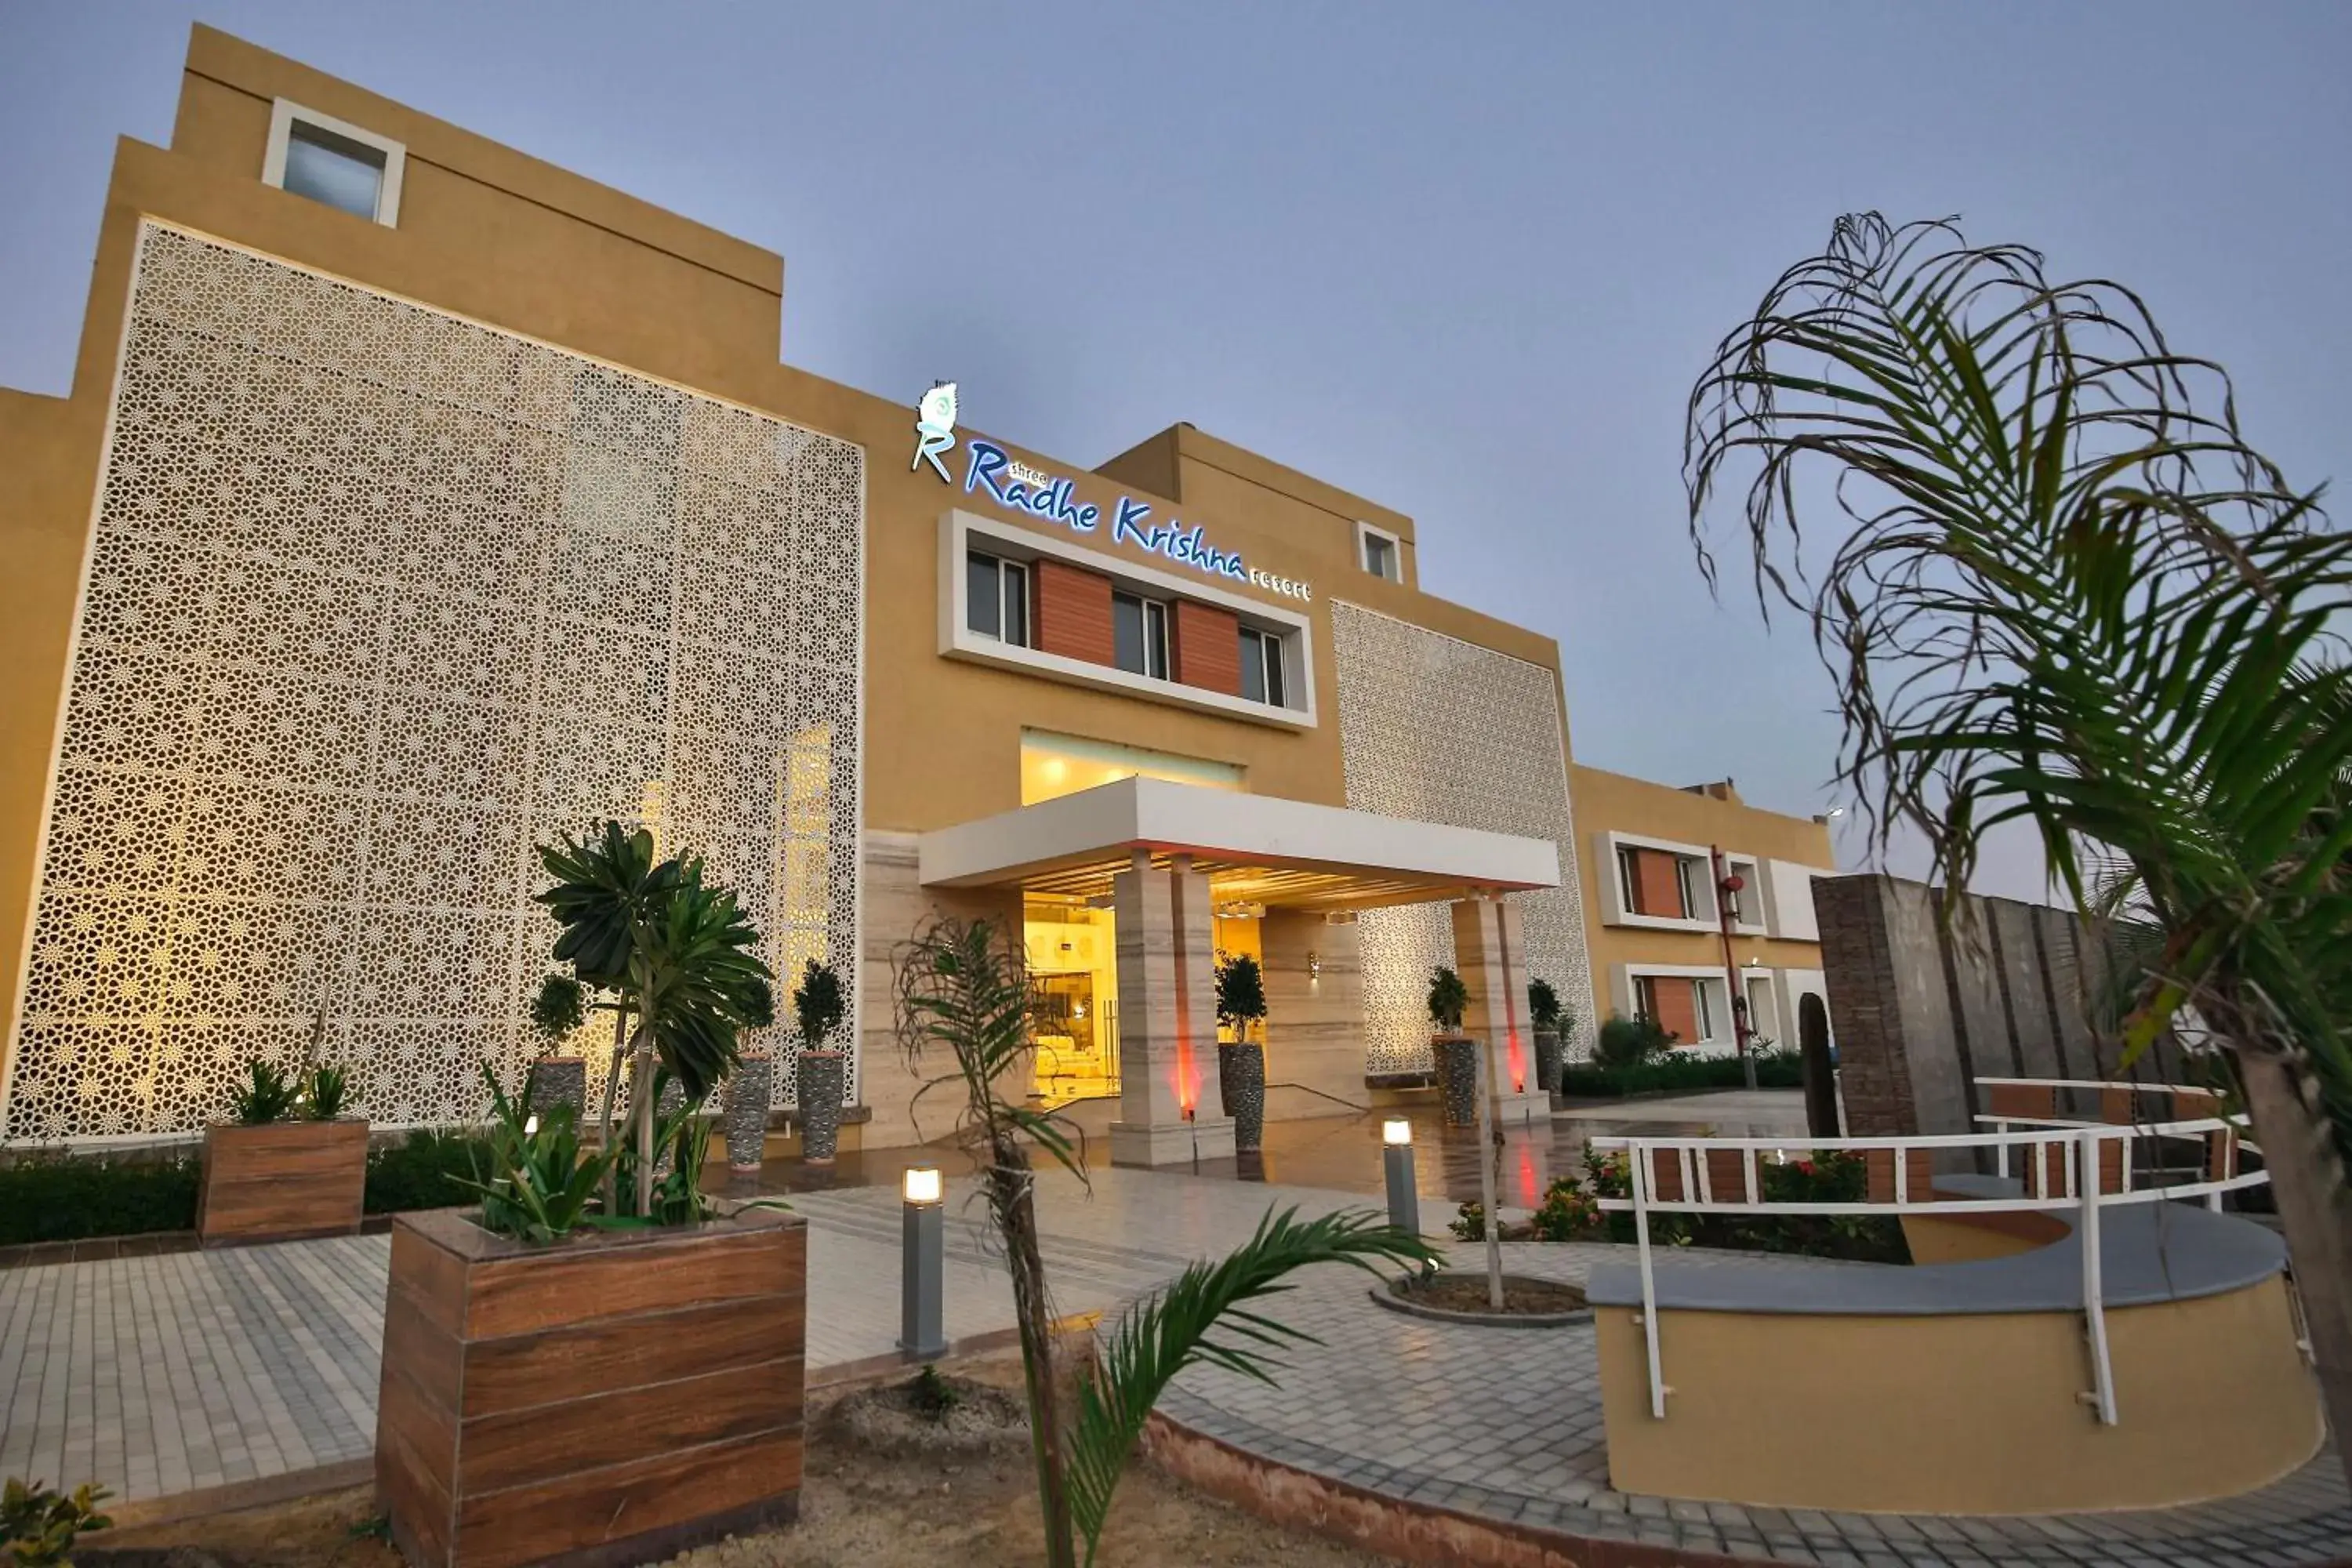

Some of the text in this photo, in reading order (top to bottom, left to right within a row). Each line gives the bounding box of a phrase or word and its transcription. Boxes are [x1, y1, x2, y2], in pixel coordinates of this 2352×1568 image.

[912, 421, 956, 484] R
[1009, 461, 1048, 487] shree
[967, 441, 1312, 601] Radhe Krishna resort
